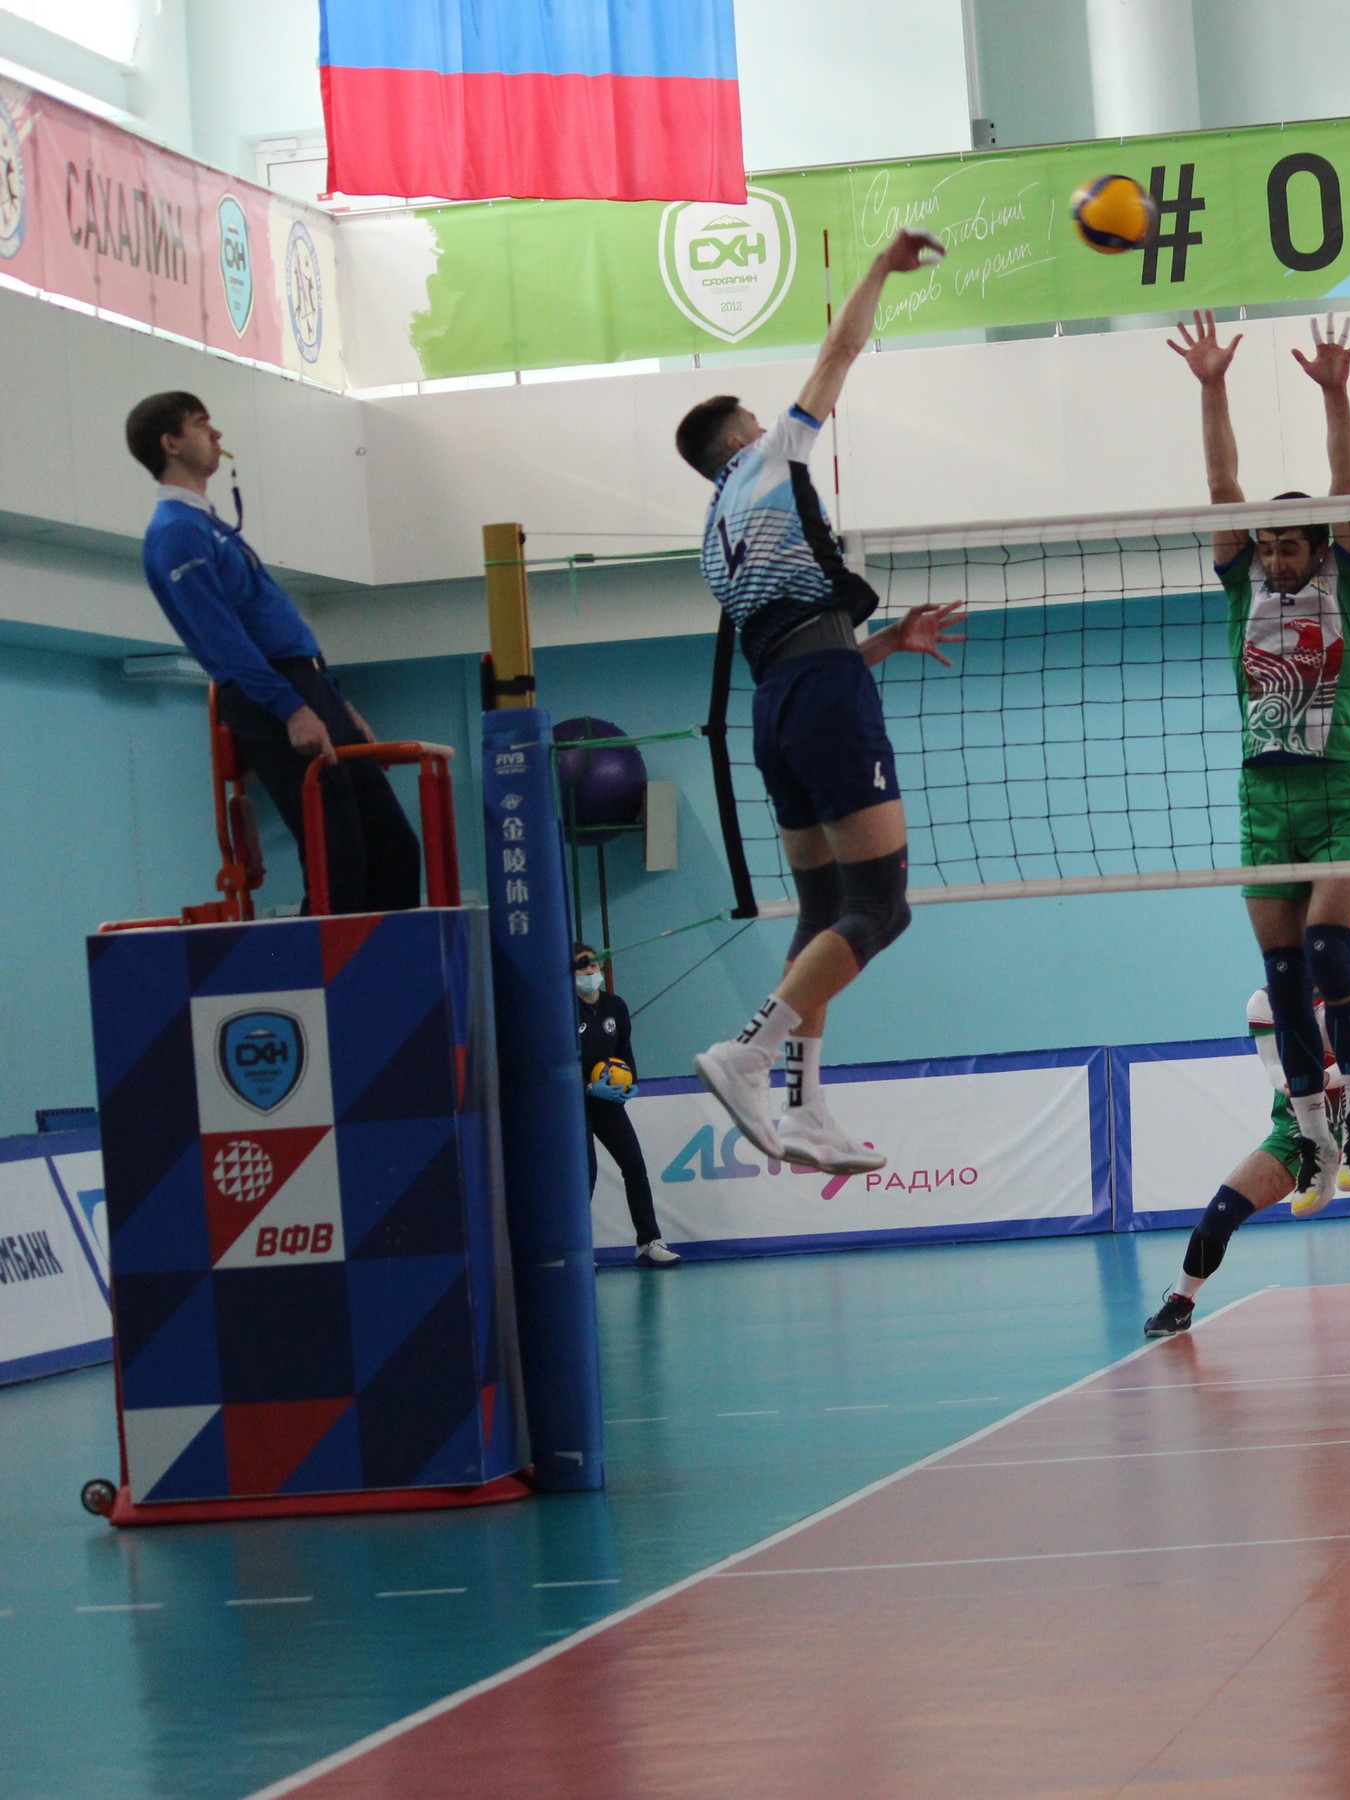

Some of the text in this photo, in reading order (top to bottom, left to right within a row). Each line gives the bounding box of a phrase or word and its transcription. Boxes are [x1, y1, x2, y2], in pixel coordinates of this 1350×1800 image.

[702, 274, 757, 287] САХАЛИН
[720, 301, 742, 312] 2012
[873, 761, 886, 790] 4
[502, 816, 530, 936] 金陵体育
[866, 1167, 979, 1194] РАДИО
[256, 1223, 334, 1257] ВФВ
